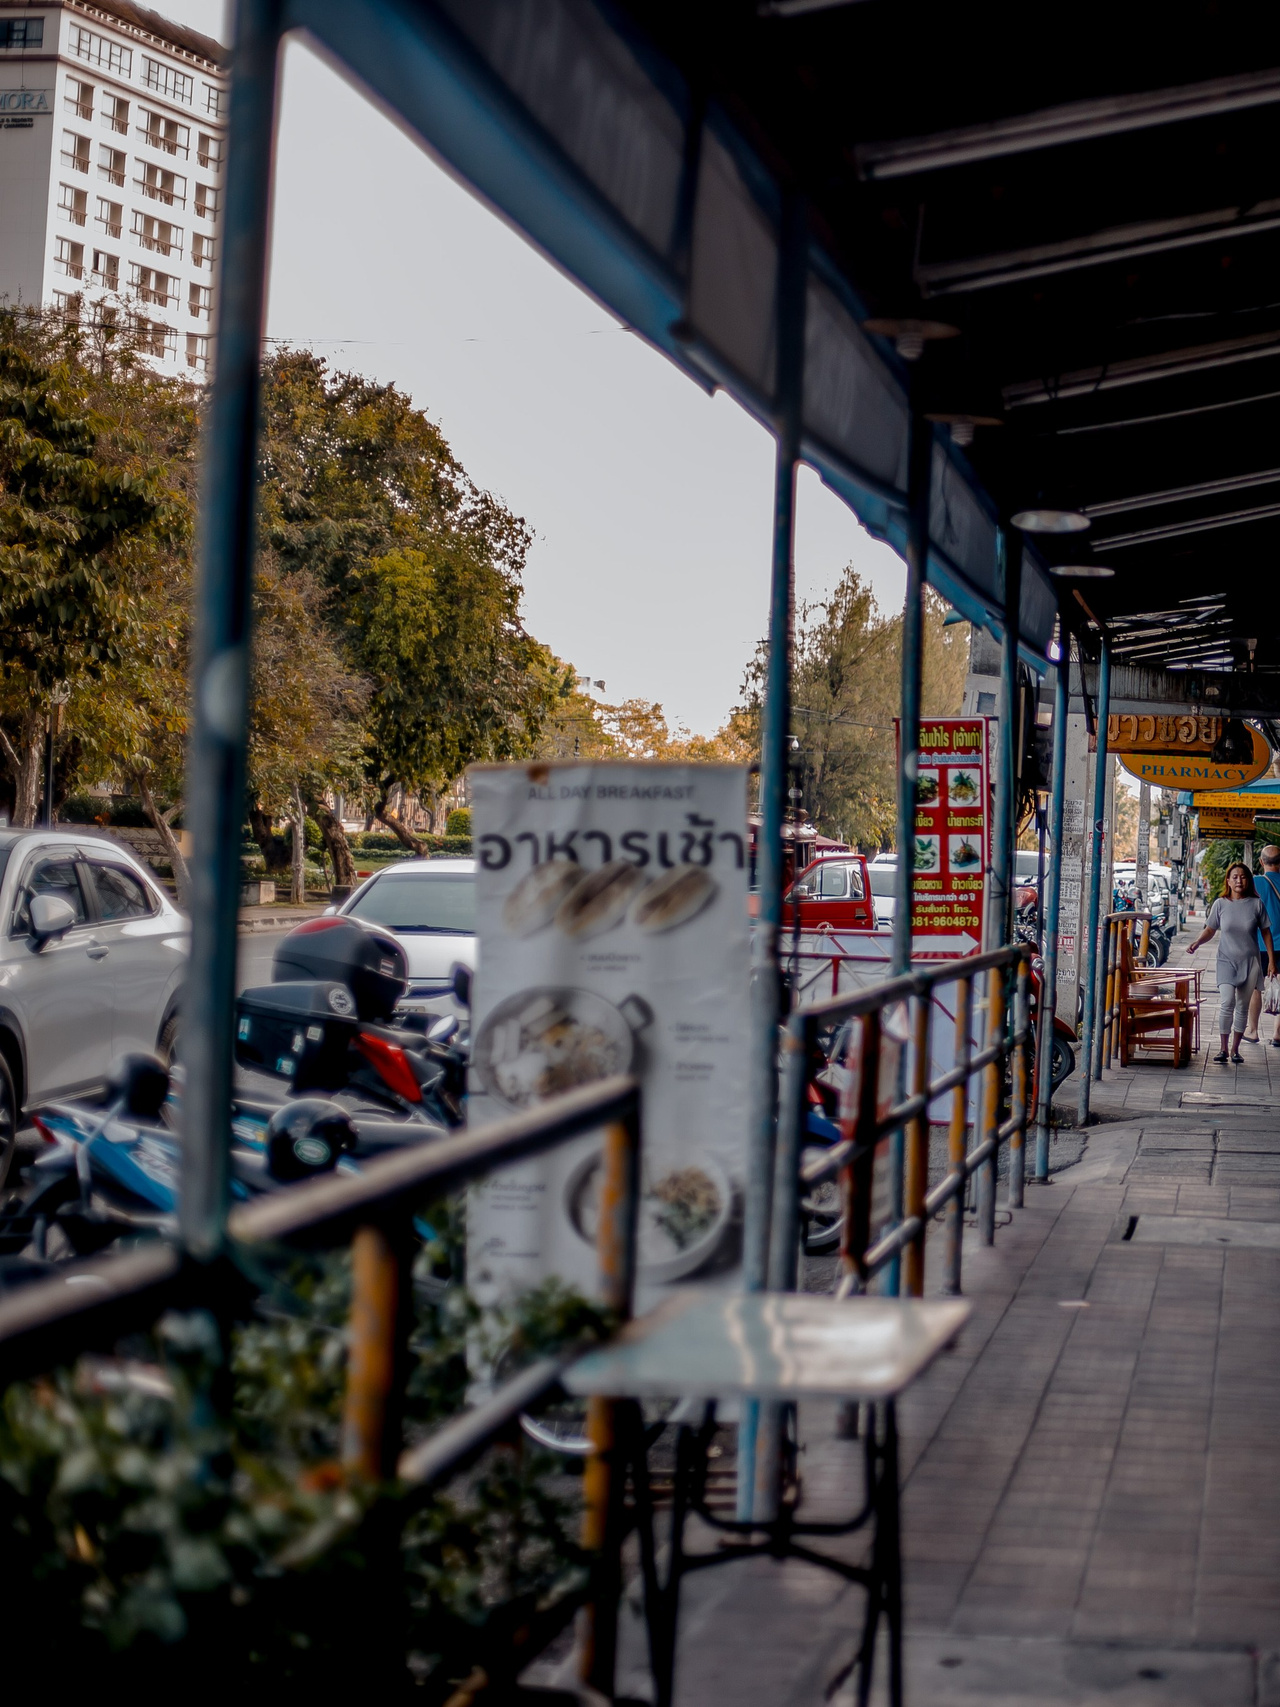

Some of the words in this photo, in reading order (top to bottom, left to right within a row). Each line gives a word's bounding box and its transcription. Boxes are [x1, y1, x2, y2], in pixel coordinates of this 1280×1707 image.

[0, 92, 49, 110] ORA
[1141, 764, 1250, 781] PHARMACY
[528, 785, 555, 800] ALL
[559, 785, 591, 800] DAY
[597, 784, 694, 800] BREAKFAST
[478, 814, 745, 871] อาหารเช้า
[958, 893, 968, 902] 40
[969, 892, 976, 902] ปี
